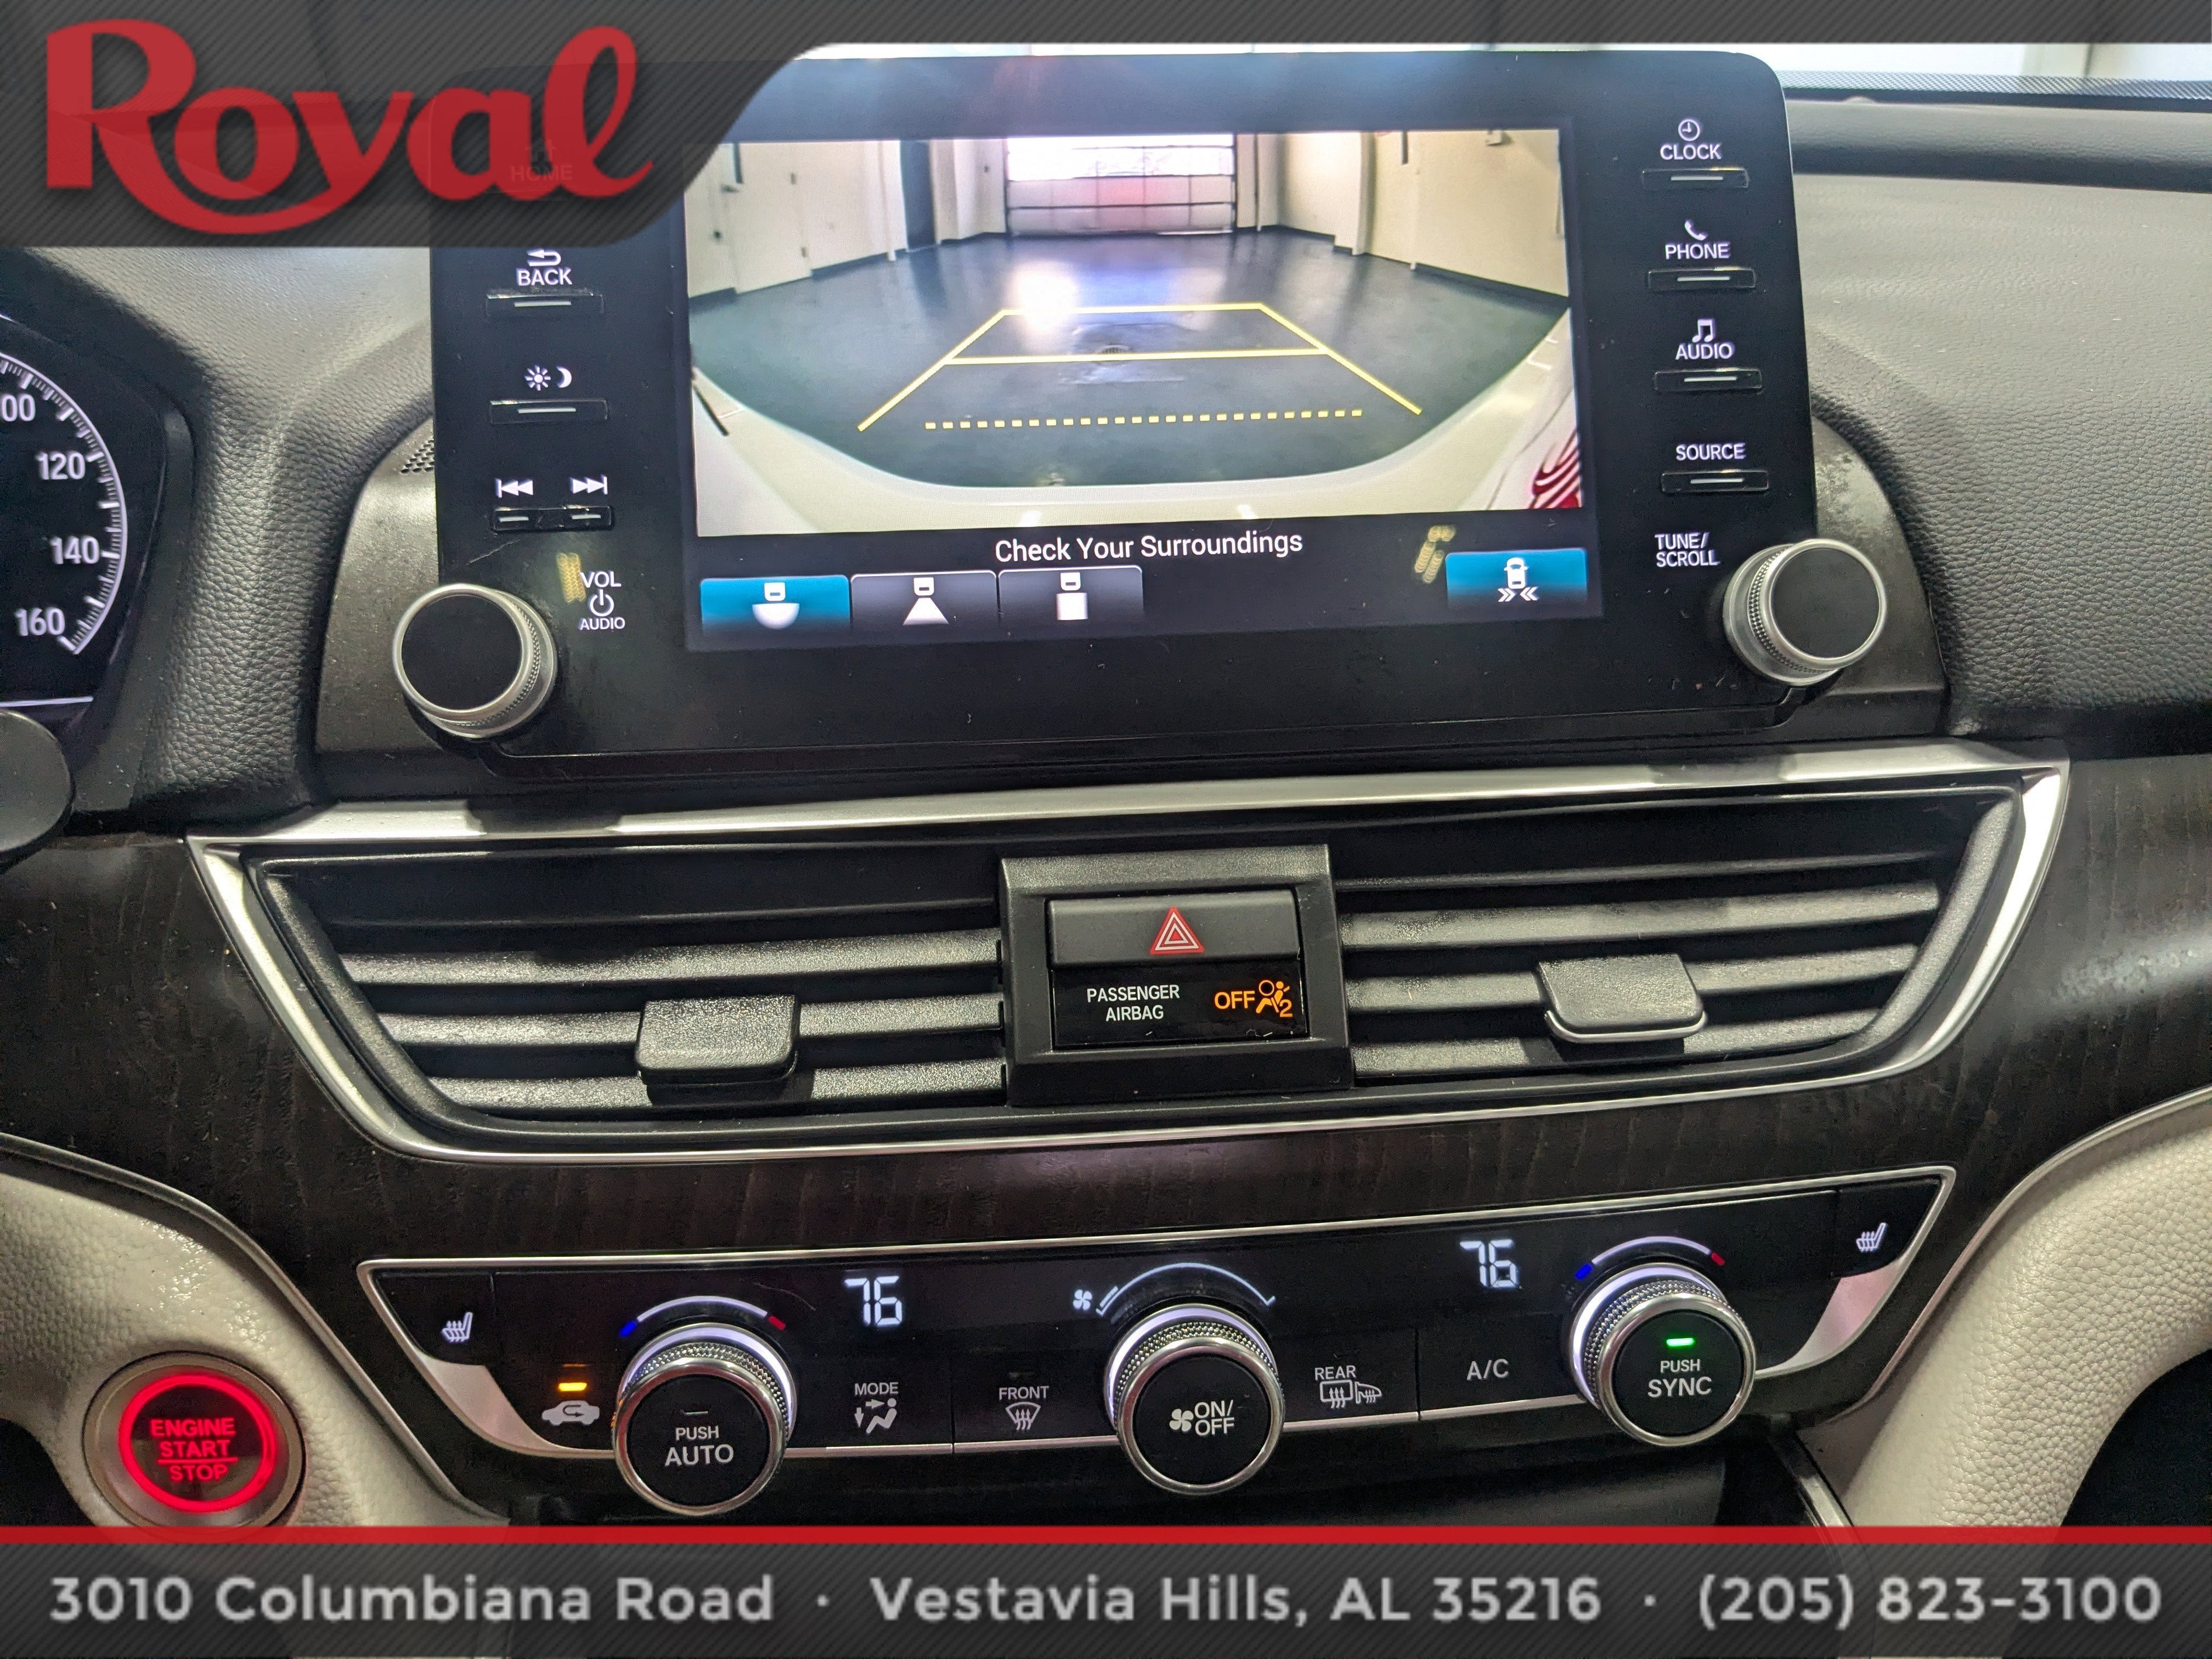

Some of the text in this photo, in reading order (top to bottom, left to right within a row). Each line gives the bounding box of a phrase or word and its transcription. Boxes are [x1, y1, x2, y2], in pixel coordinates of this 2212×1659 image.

[1660, 143, 1722, 160] CLOCK
[510, 165, 573, 182] HOME
[1665, 242, 1731, 259] PHONE
[517, 268, 573, 286] BACK
[1675, 342, 1735, 360] AUDIO
[1676, 443, 1746, 460] SOURCE
[37, 451, 86, 481] 120
[50, 535, 100, 565] 140
[995, 531, 1303, 562] Check Your Surroundings
[1655, 532, 1709, 550] TUNE/
[1656, 550, 1721, 567] SCROLL
[580, 571, 622, 588] VOL
[16, 608, 65, 637] 160
[579, 617, 625, 630] AUDIO
[1087, 984, 1180, 1002] PASSENGER
[1214, 990, 1256, 1009] OFF
[1105, 1005, 1164, 1022] AIRBAG
[1279, 1000, 1293, 1018] 2
[1460, 1239, 1517, 1288] 76
[844, 1276, 903, 1327] 76
[1314, 1365, 1356, 1380] REAR
[1467, 1359, 1509, 1380] A/C
[1660, 1359, 1701, 1374] PUSH
[854, 1382, 899, 1396] MODE
[998, 1385, 1049, 1400] FRONT
[1647, 1378, 1712, 1398] SYNC
[1194, 1400, 1234, 1418] ON/
[150, 1418, 236, 1436] ENGINE
[675, 1426, 719, 1441] PUSH
[1195, 1418, 1235, 1436] OFF
[159, 1440, 231, 1458] START
[665, 1444, 734, 1466] AUTO
[169, 1465, 228, 1481] STOP
